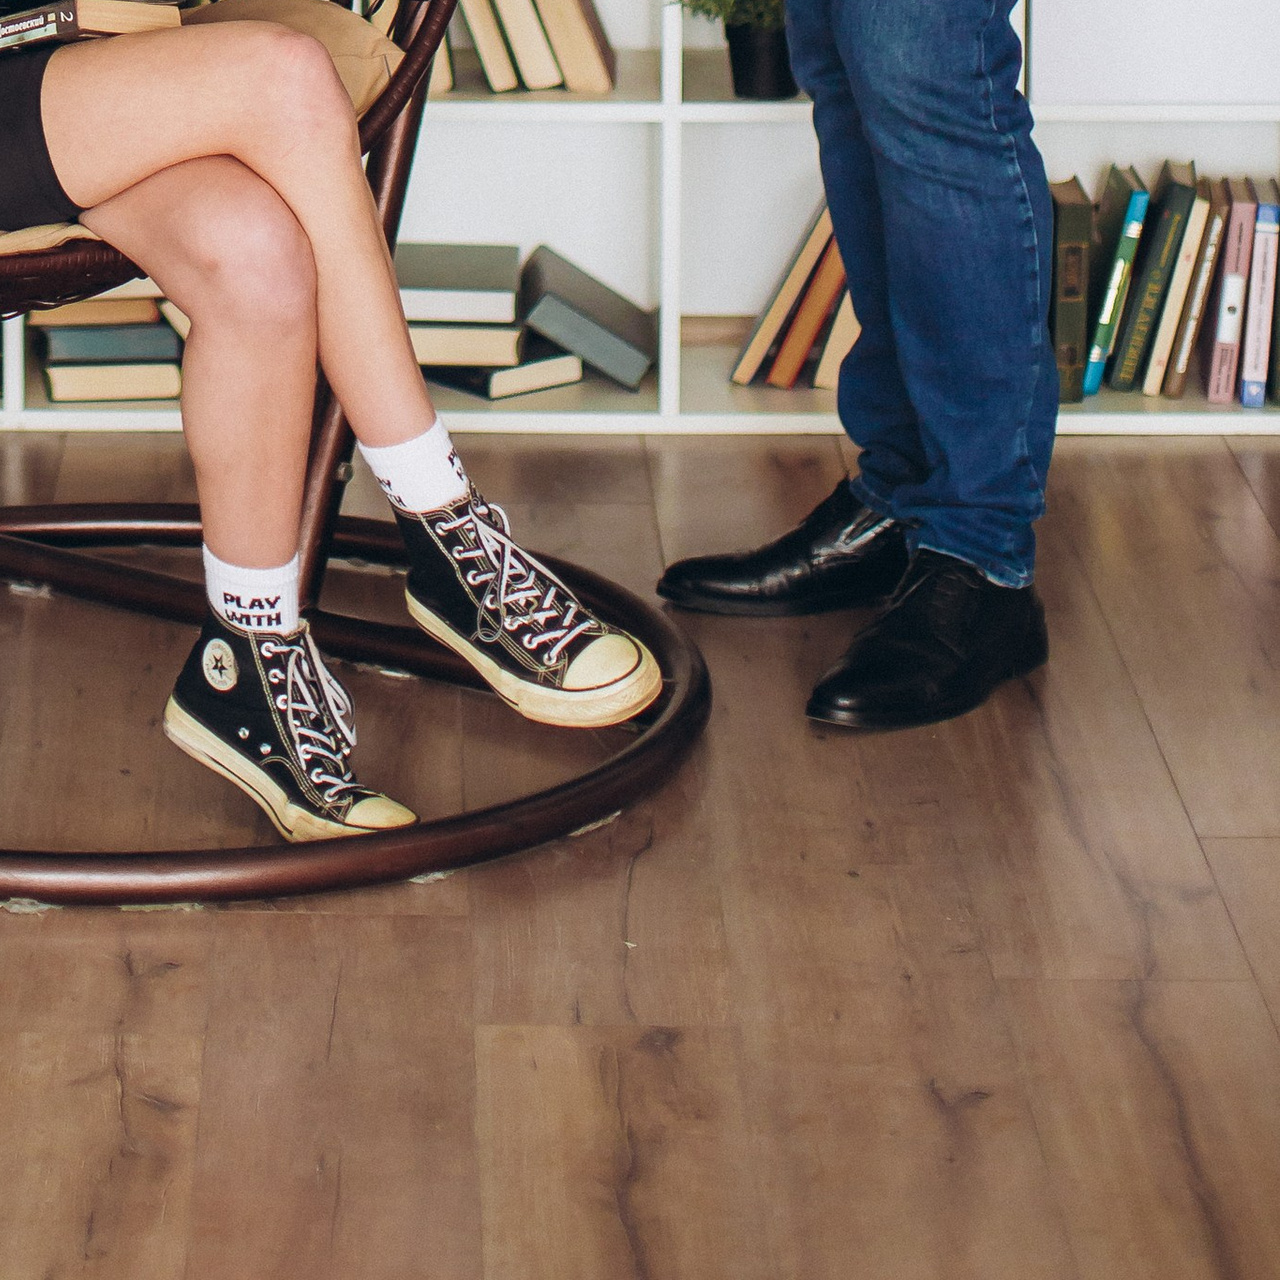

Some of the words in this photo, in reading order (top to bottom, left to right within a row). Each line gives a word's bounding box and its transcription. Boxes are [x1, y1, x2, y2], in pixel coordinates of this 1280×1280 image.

[60, 11, 73, 22] 2
[223, 592, 282, 610] PLAY
[225, 609, 282, 627] WITH
